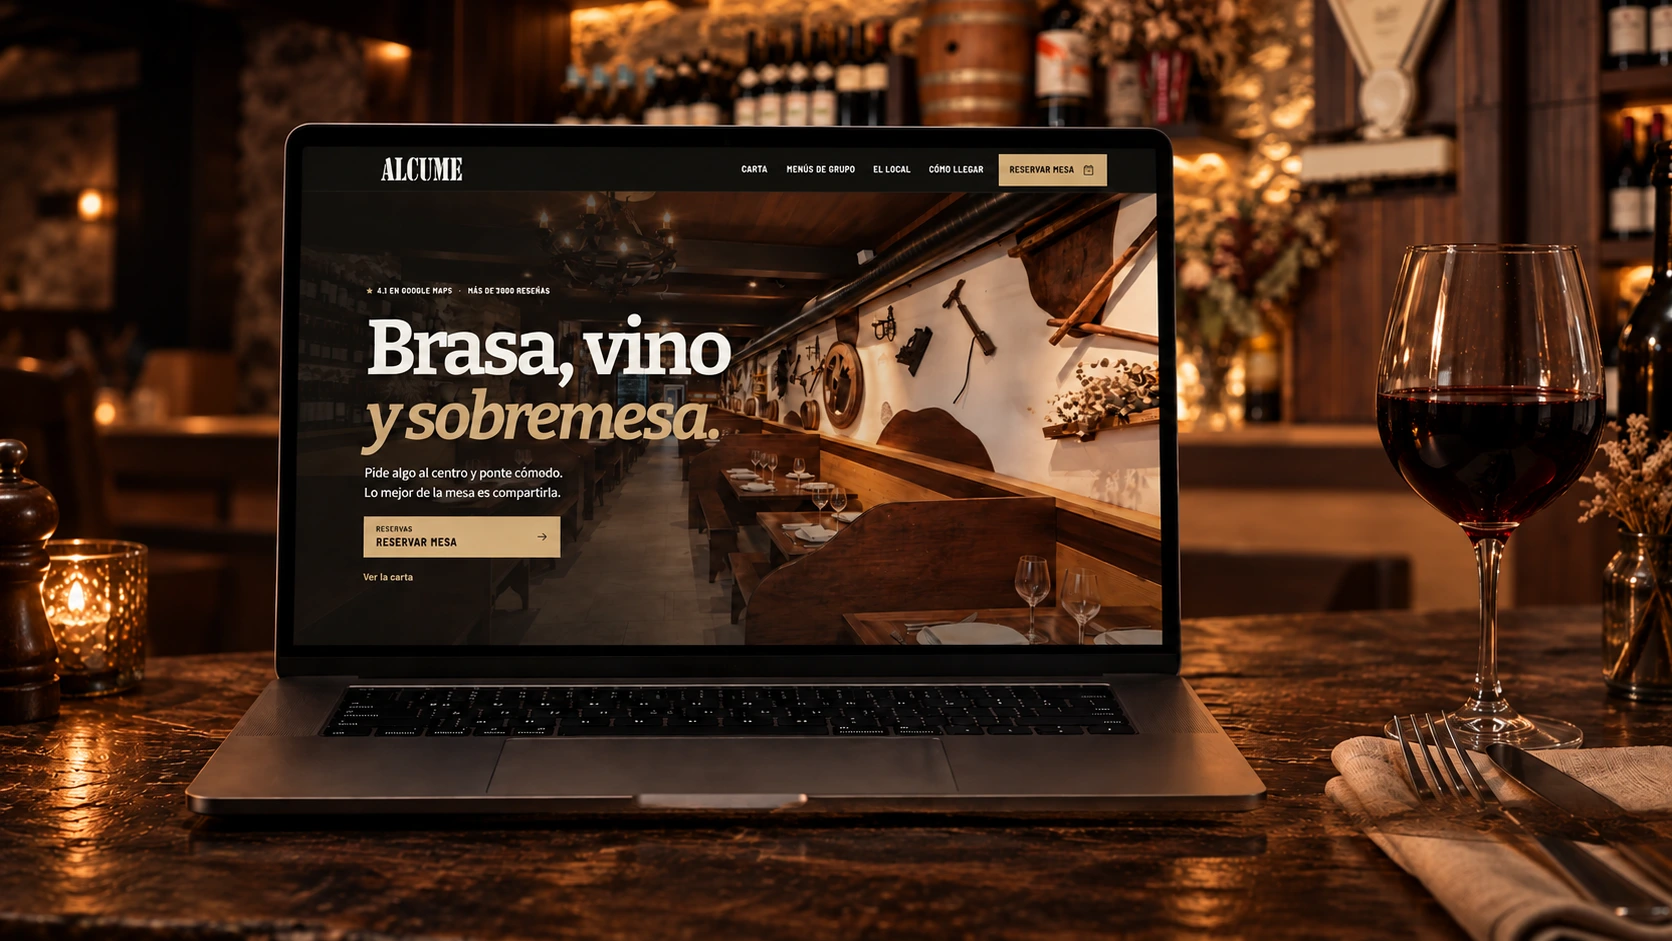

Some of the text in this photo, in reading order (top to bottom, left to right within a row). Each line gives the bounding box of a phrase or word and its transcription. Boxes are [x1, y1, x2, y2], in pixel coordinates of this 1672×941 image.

[380, 156, 463, 182] ALCUME
[741, 164, 768, 174] CARTA
[786, 163, 856, 174] MENÚS DE GRUPO
[873, 165, 911, 174] EL LOCAL
[928, 163, 984, 174] CÓMO LLEGAR
[1009, 165, 1075, 174] RESERVAR MESA
[389, 287, 400, 295] EN
[432, 287, 453, 295] MAPS
[467, 285, 483, 295] MÁS
[484, 287, 495, 295] DE
[516, 285, 551, 295] RESEÑAS
[367, 313, 732, 388] Brasa, vino
[360, 387, 721, 456] y sobremesa.
[364, 466, 563, 482] Pide algo al centro y ponte cómodo.
[364, 486, 561, 501] Lo mejor de la mesa es compartirla.
[375, 525, 413, 533] RESERVAS
[376, 537, 457, 547] RESERVAR MESA
[362, 572, 414, 582] Ver la carta
